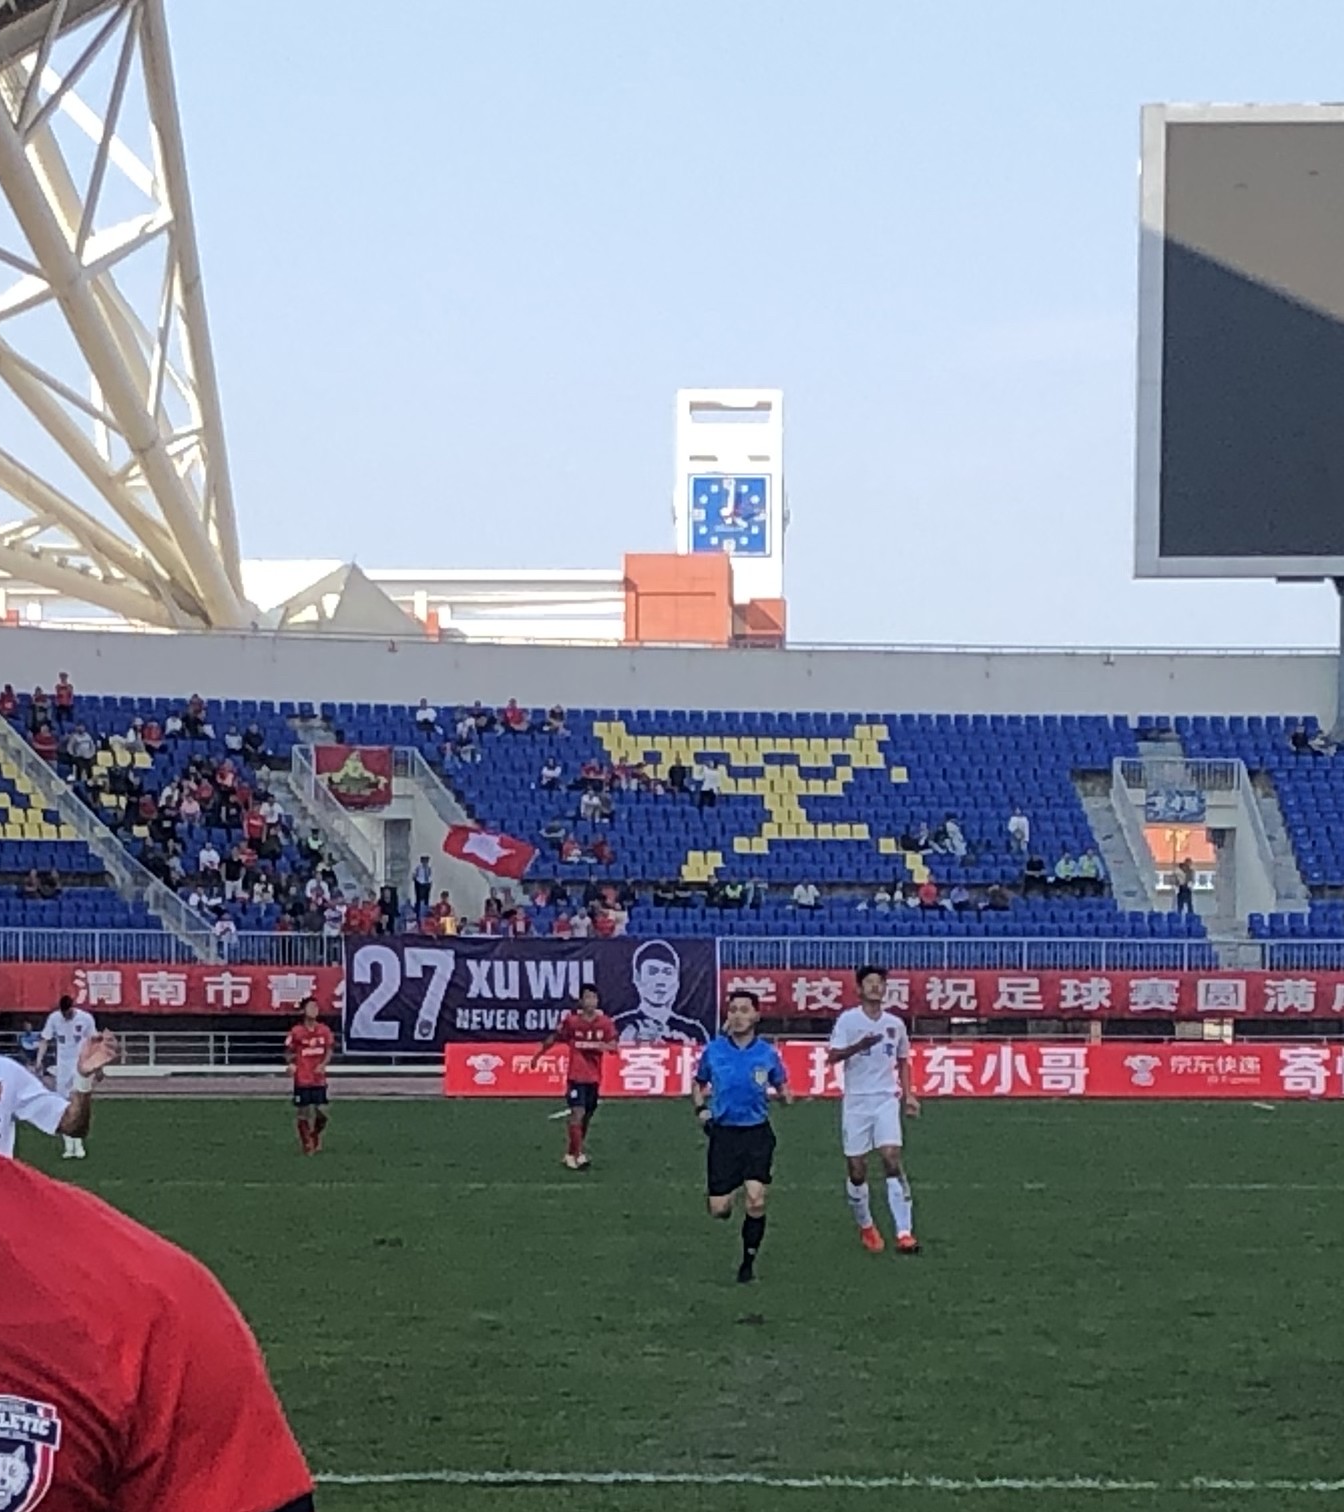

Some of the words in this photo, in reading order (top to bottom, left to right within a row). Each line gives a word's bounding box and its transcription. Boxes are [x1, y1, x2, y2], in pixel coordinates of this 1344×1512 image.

[73, 969, 344, 1009] 渭南市青
[350, 944, 455, 1040] 27
[466, 959, 519, 1000] XU
[456, 1008, 519, 1030] NEVER
